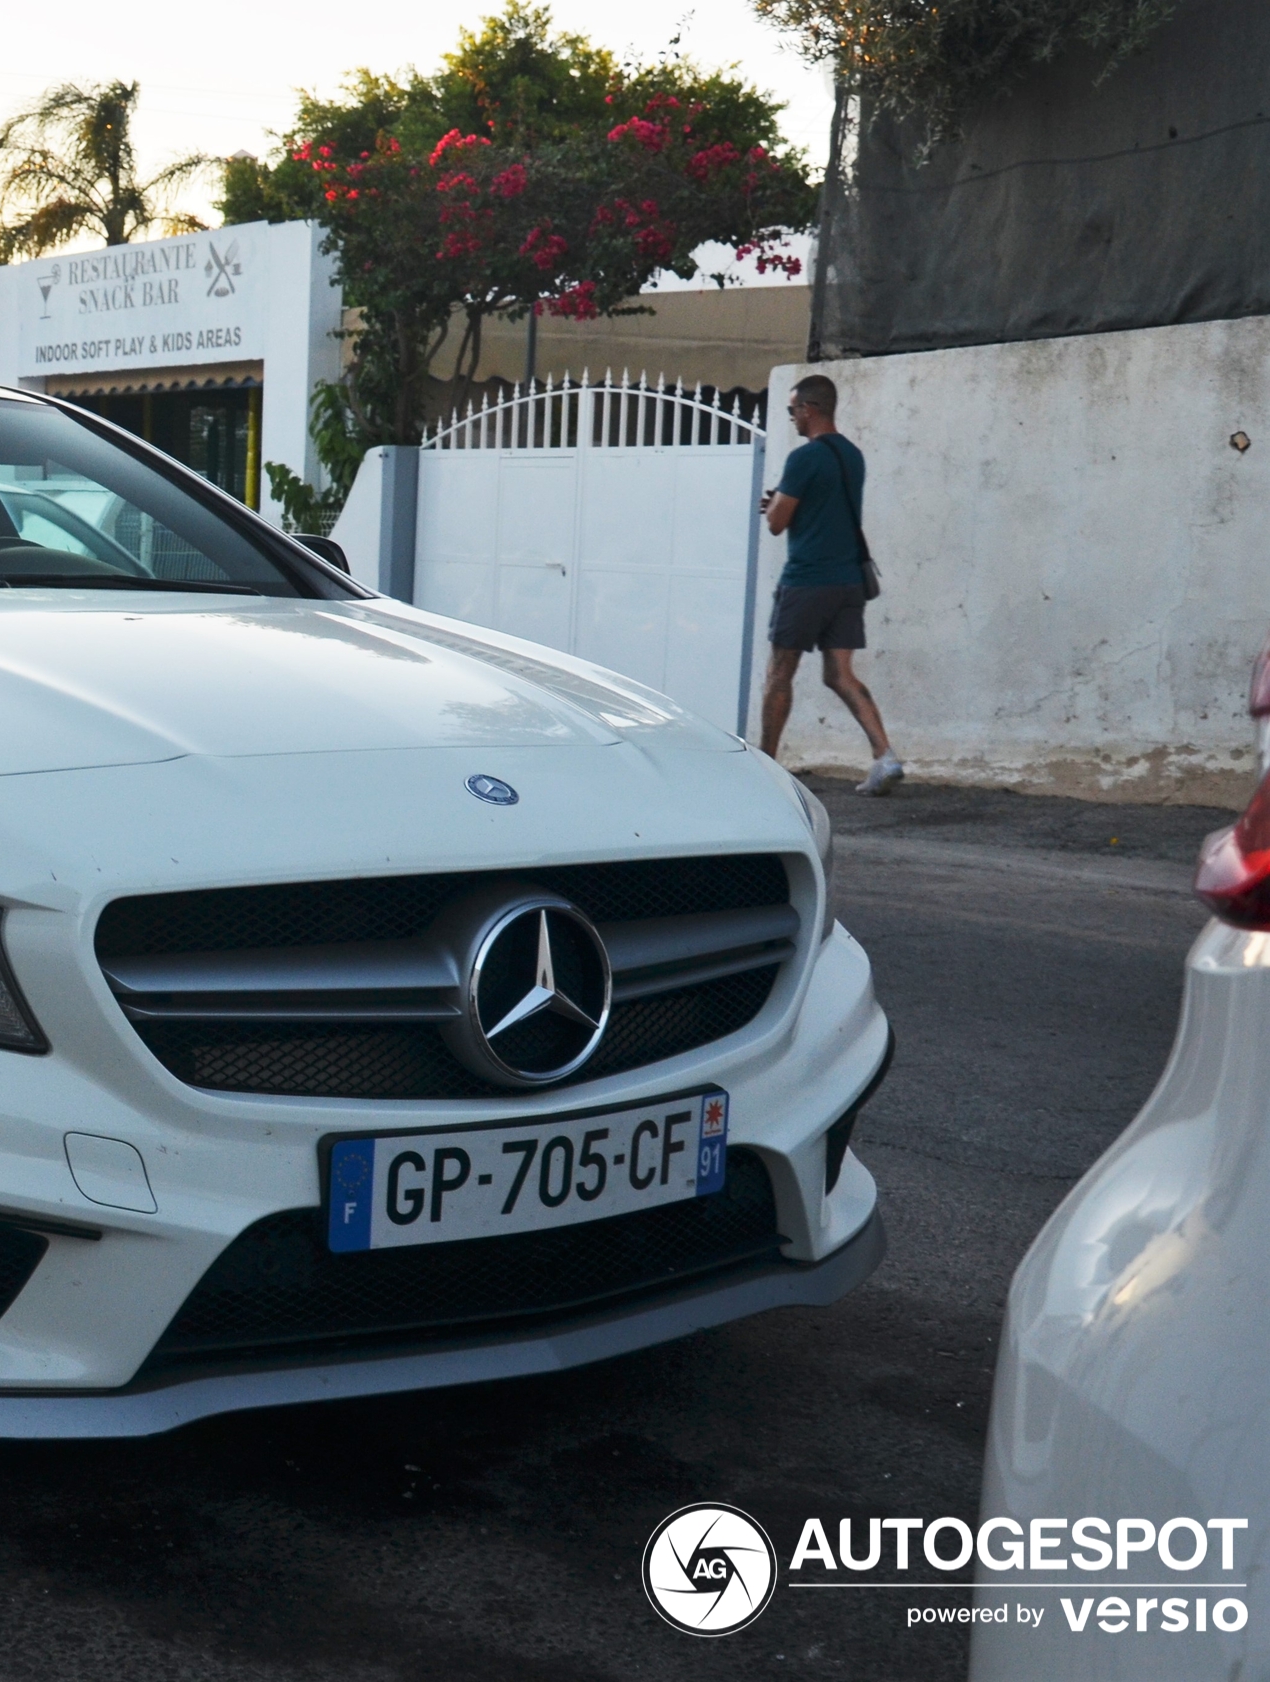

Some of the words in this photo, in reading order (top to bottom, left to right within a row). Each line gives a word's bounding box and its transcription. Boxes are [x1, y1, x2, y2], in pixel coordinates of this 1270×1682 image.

[68, 243, 196, 286] RESTAURANTE
[78, 283, 135, 315] SNACK
[142, 278, 179, 307] BAR
[35, 343, 78, 363] INDOOR
[81, 340, 111, 360] SOFT
[114, 336, 145, 358] PLAY
[149, 334, 157, 354] &
[162, 331, 193, 353] KIDS
[196, 326, 241, 350] AREAS
[385, 1110, 692, 1226] GP-705-CF
[700, 1143, 721, 1177] 91
[343, 1202, 356, 1225] F
